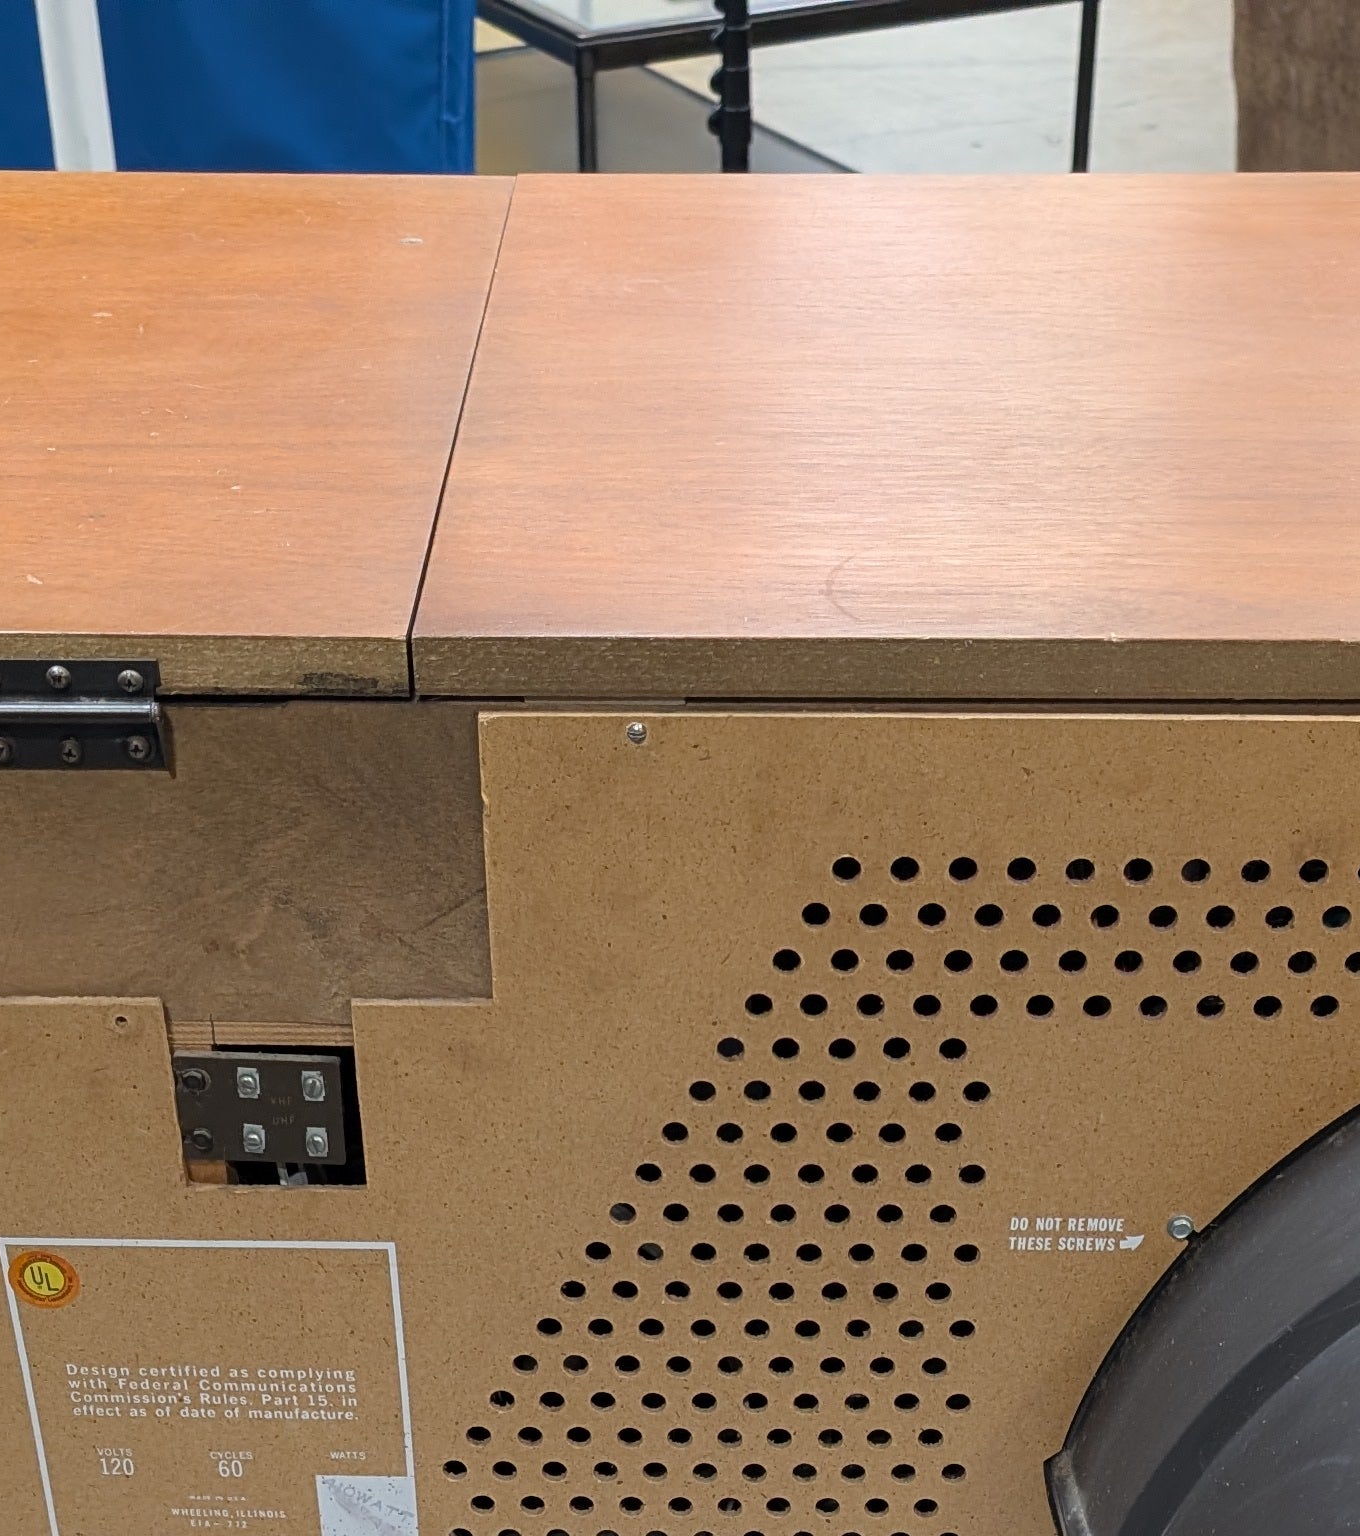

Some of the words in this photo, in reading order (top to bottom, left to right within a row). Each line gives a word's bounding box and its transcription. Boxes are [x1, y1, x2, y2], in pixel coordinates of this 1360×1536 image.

[1010, 1217, 1029, 1231] DO
[1036, 1218, 1063, 1231] NOT
[1067, 1218, 1125, 1232] REMOVE
[1009, 1236, 1052, 1251] THESE
[1057, 1237, 1116, 1252] SCREWS
[29, 1265, 60, 1292] UL
[65, 1363, 130, 1378] Design
[139, 1364, 220, 1378] certified
[229, 1368, 249, 1378] as
[257, 1367, 356, 1382] complying
[68, 1378, 108, 1389] with
[118, 1378, 188, 1391] Federal
[199, 1379, 357, 1393] Communications
[70, 1391, 192, 1404] Commission's
[261, 1394, 299, 1406] Part
[342, 1395, 358, 1407] in
[73, 1404, 122, 1417] effect
[129, 1407, 147, 1417] as
[155, 1406, 171, 1417] of
[180, 1406, 216, 1418] date
[224, 1407, 240, 1418] of
[248, 1407, 359, 1420] manufacture.
[97, 1448, 133, 1458] VOLTS
[209, 1451, 254, 1460] CYCLES
[329, 1452, 366, 1460] WATTS
[99, 1458, 135, 1476] 120
[218, 1460, 243, 1478] 60
[171, 1508, 234, 1519] WHEELING,
[236, 1510, 287, 1519] ILLINOIS
